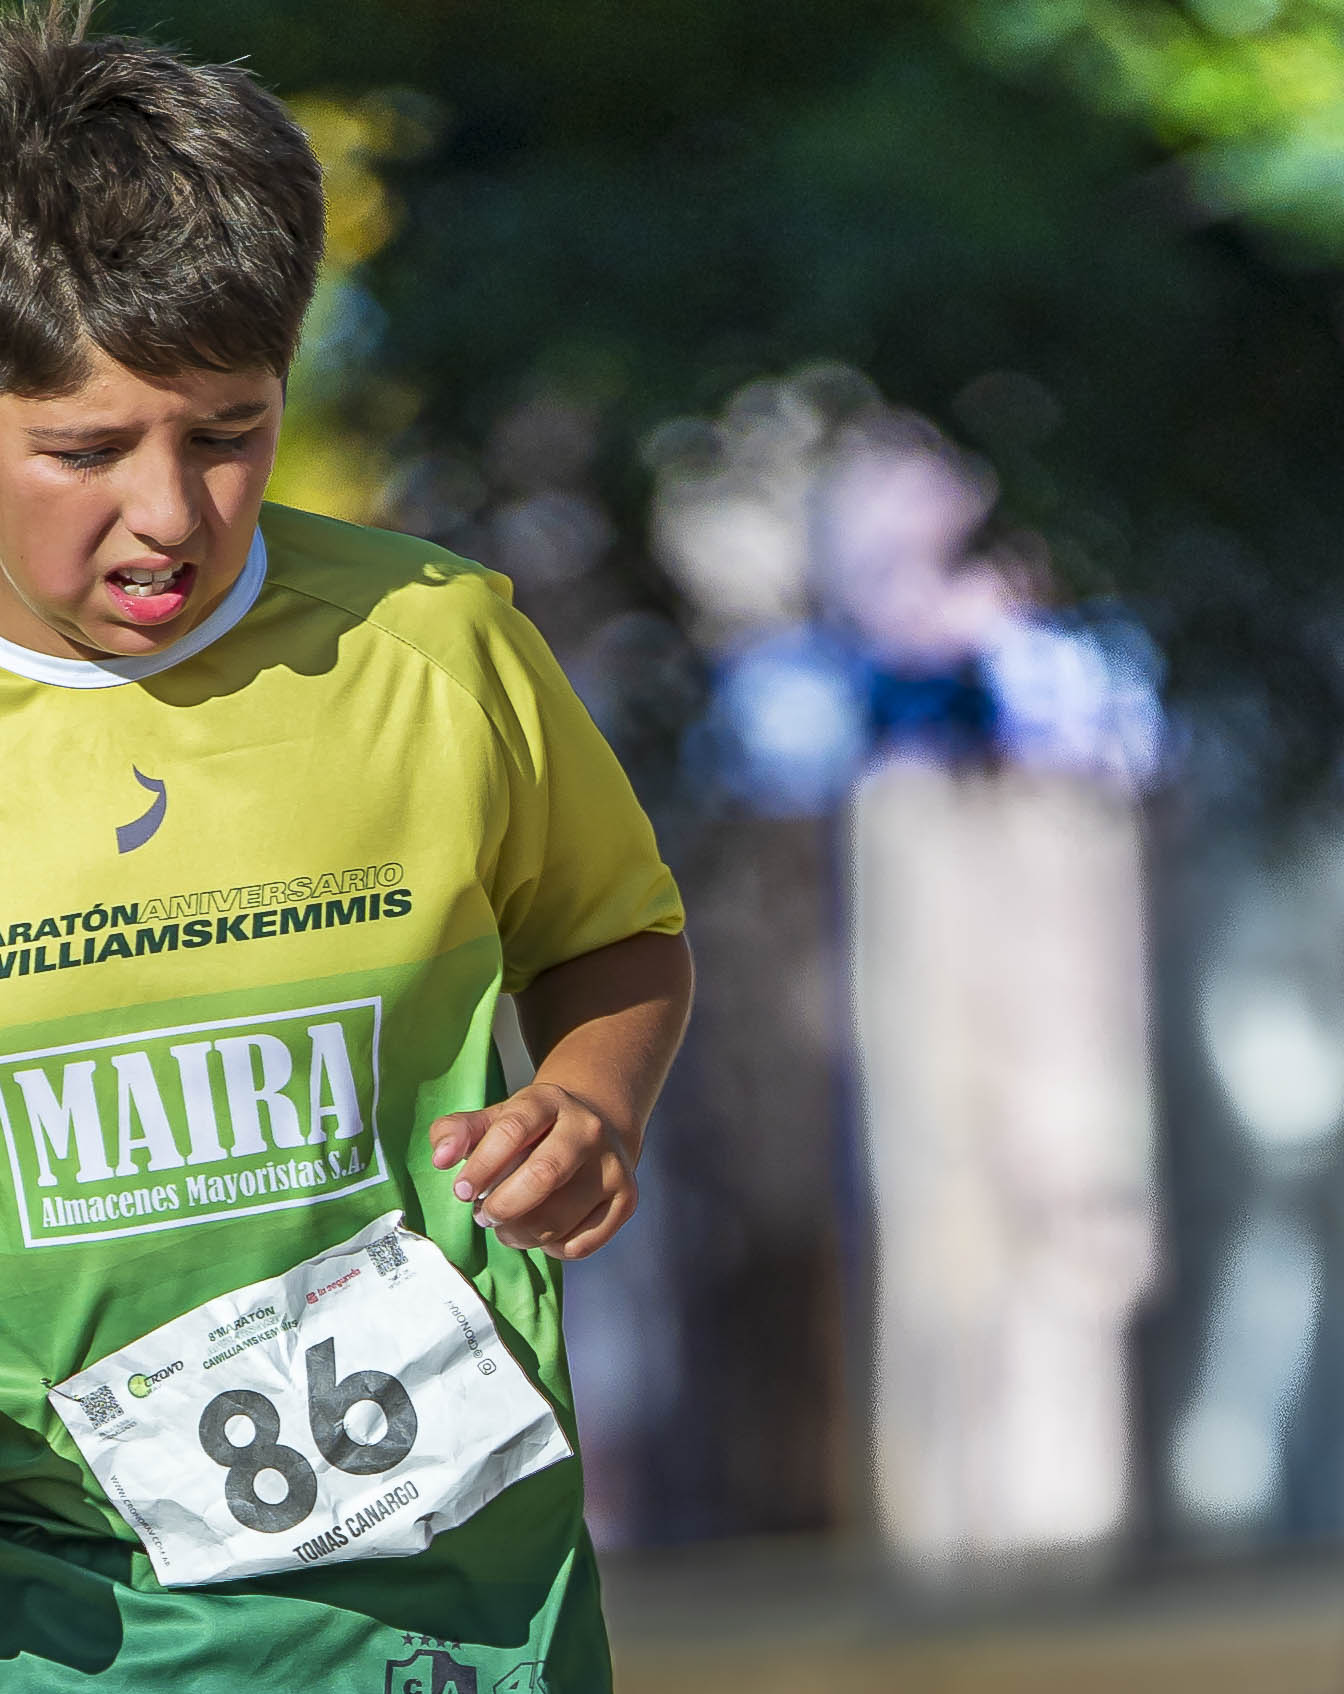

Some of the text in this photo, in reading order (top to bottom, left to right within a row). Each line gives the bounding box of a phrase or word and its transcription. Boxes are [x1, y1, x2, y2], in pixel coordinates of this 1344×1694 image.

[136, 861, 405, 924] ANIVERSARIO
[13, 1022, 364, 1187] MAIRA
[42, 1146, 366, 1228] Almacenes Mayoristas S.A.
[199, 1336, 418, 1533] 86
[292, 1480, 419, 1564] TOMAS CANARGO
